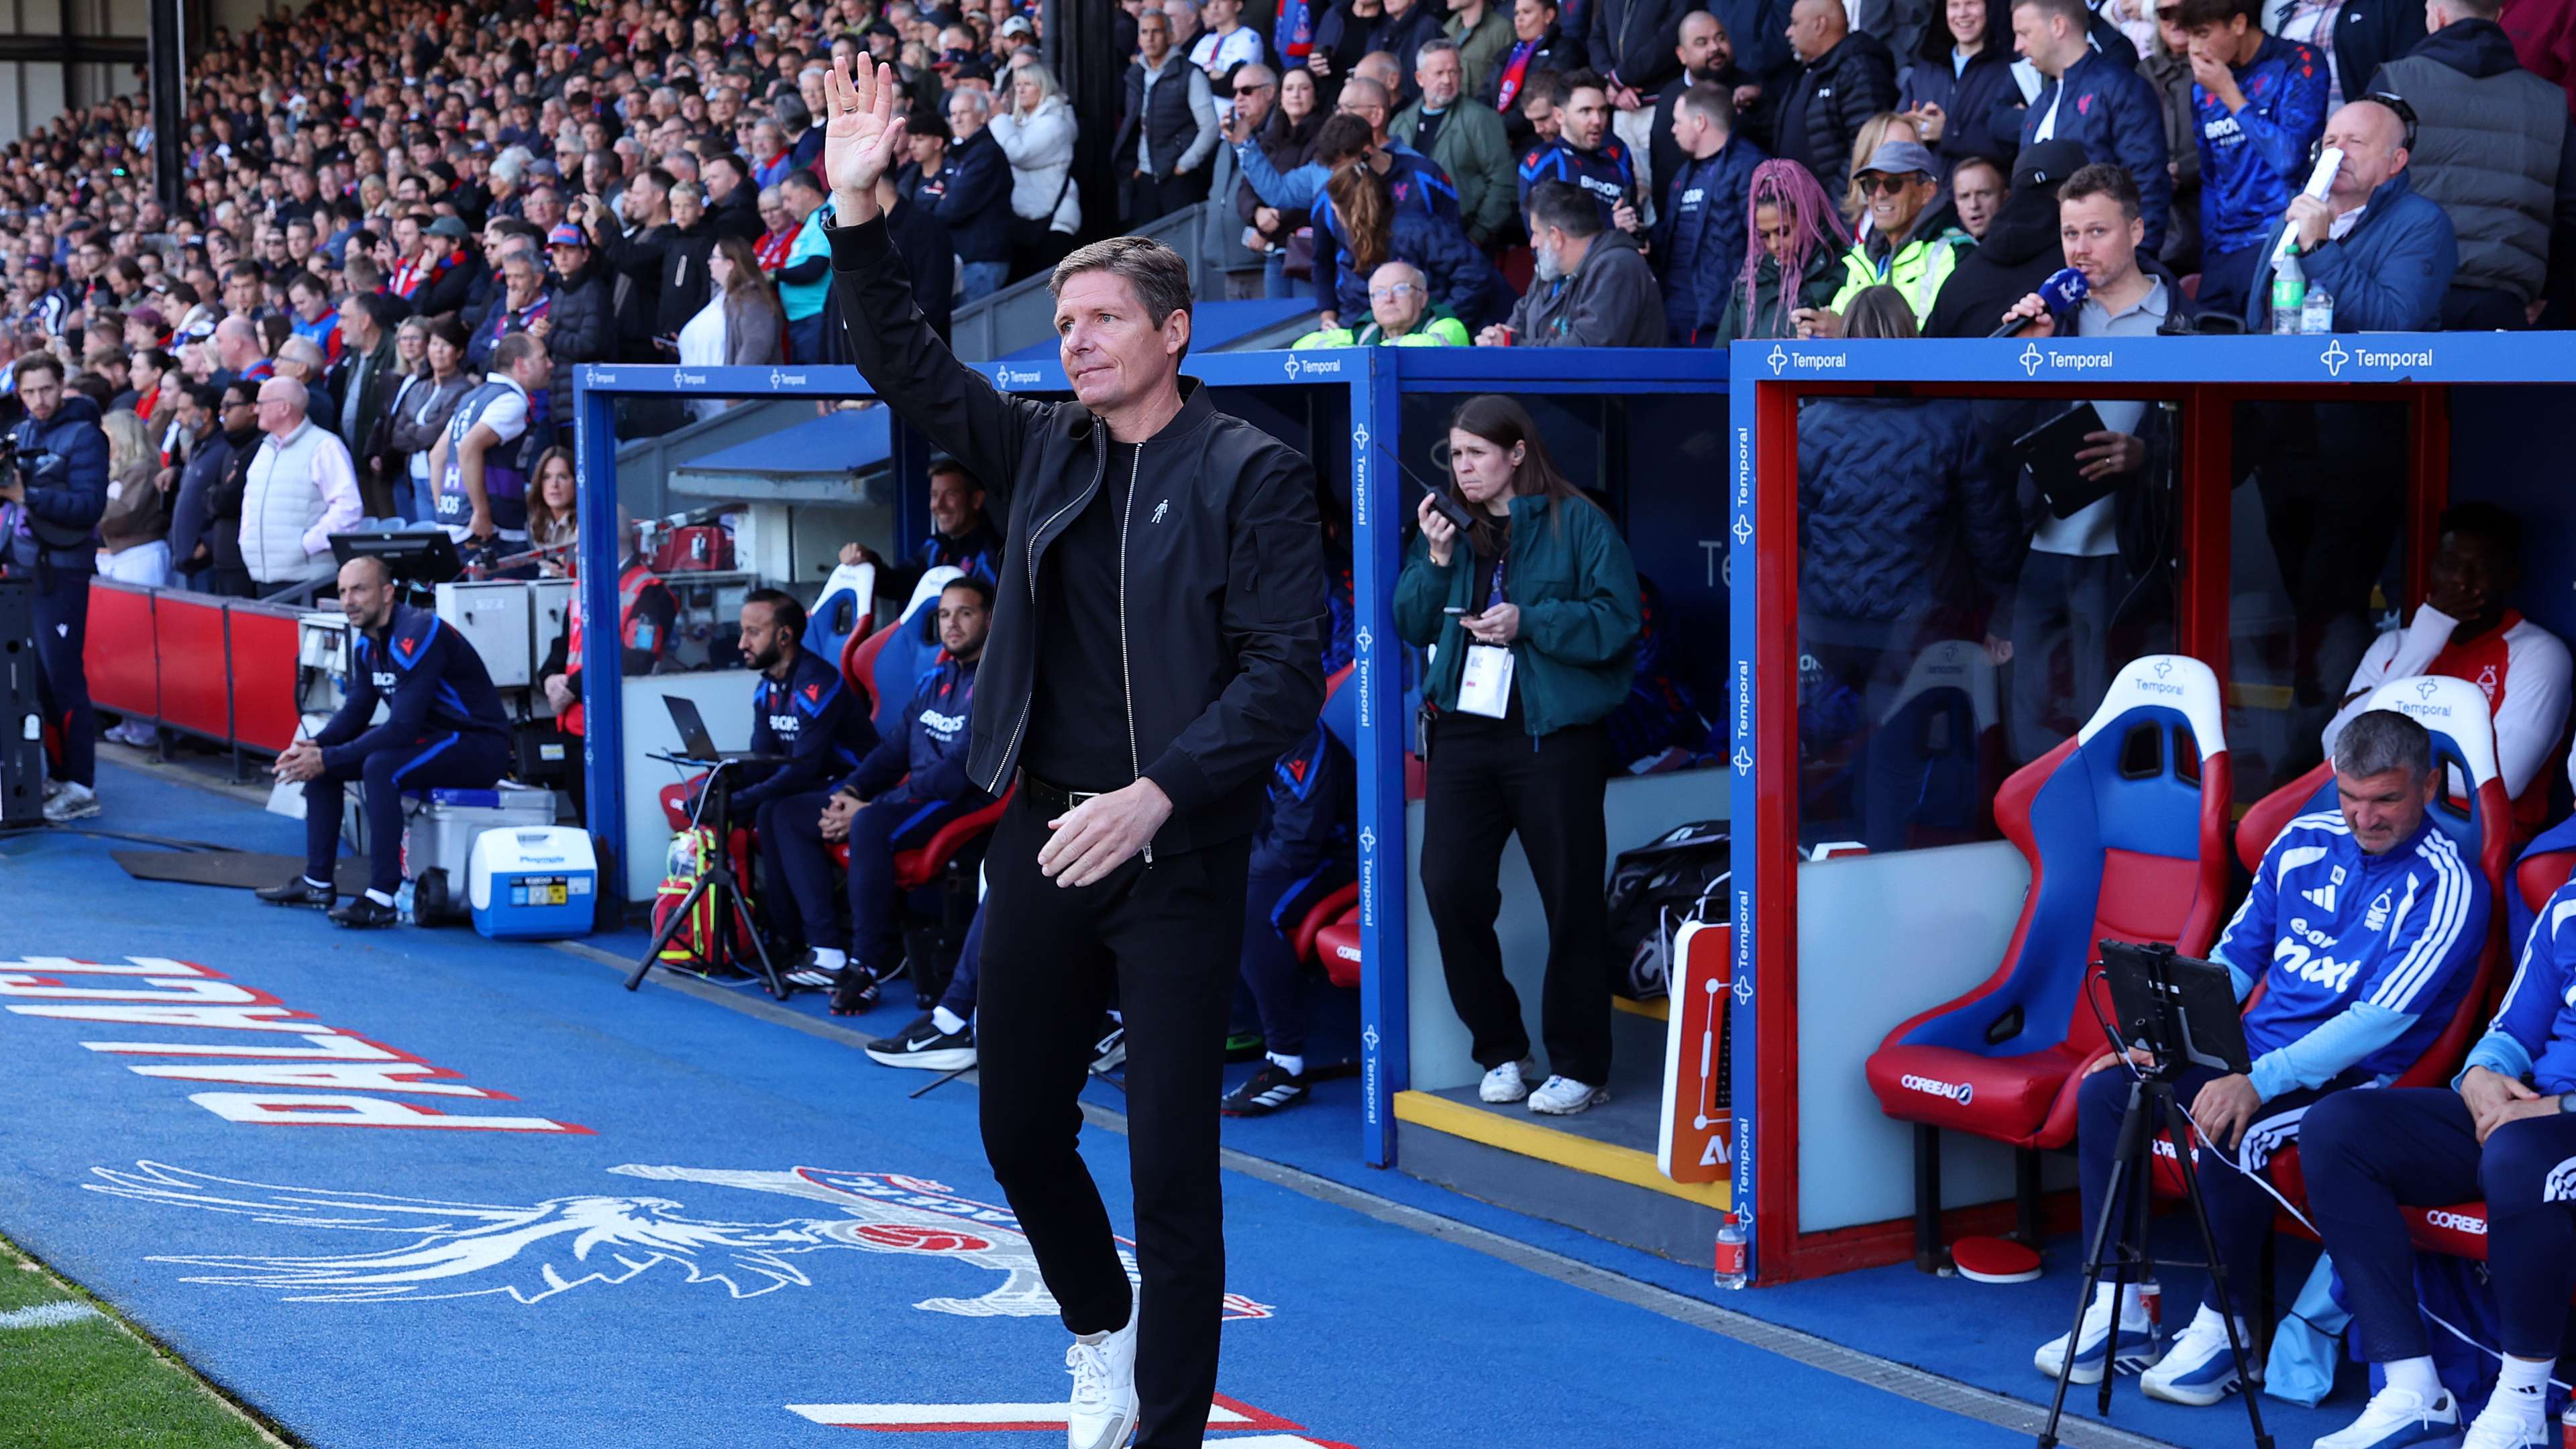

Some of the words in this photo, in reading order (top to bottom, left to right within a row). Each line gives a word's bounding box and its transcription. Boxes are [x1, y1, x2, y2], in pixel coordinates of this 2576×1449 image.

[1301, 359, 1340, 374] Temporal
[1792, 352, 1846, 370] Temporal
[2049, 351, 2113, 369] Temporal
[2355, 348, 2433, 368] Temporal
[780, 374, 806, 385] Temporal
[1010, 370, 1041, 384] Temporal
[1737, 427, 1750, 507] Temporal
[1357, 455, 1366, 526] Temporal
[1360, 657, 1370, 727] Temporal
[1738, 660, 1750, 739] Temporal
[2135, 678, 2184, 695] Temporal
[2396, 700, 2453, 716] Temporal
[1363, 858, 1373, 927] Temporal
[1738, 890, 1751, 968] Temporal
[1368, 1057, 1377, 1124] Temporal
[1900, 1073, 1958, 1099] CORBEAU
[1738, 1118, 1751, 1194] Temporal
